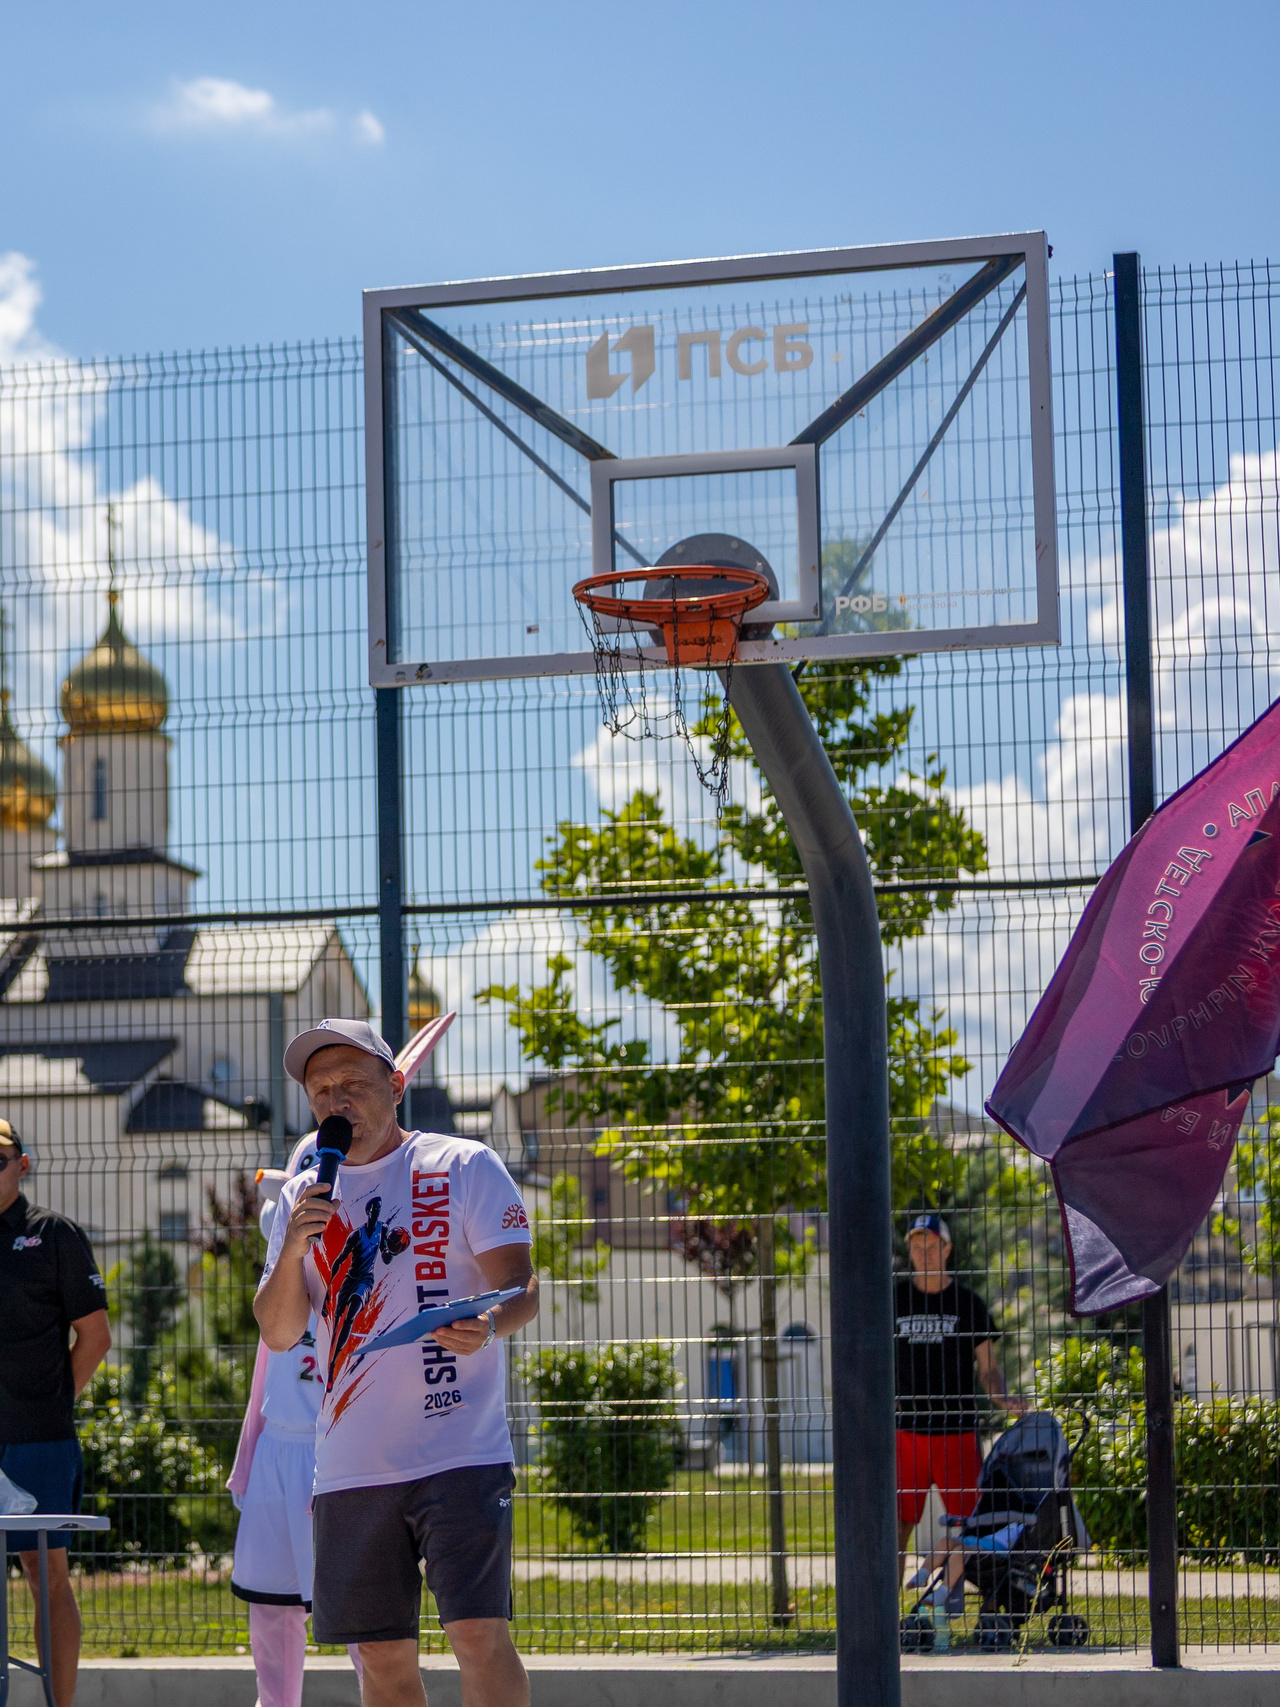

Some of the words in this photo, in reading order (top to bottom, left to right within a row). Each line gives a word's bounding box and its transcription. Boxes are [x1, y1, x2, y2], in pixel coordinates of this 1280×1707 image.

[677, 323, 814, 381] ПСБ
[835, 593, 888, 616] РФБ
[411, 1169, 450, 1281] BASKET
[416, 1285, 457, 1386] SHT
[900, 1320, 956, 1334] RUBIN
[424, 1389, 462, 1411] 2026
